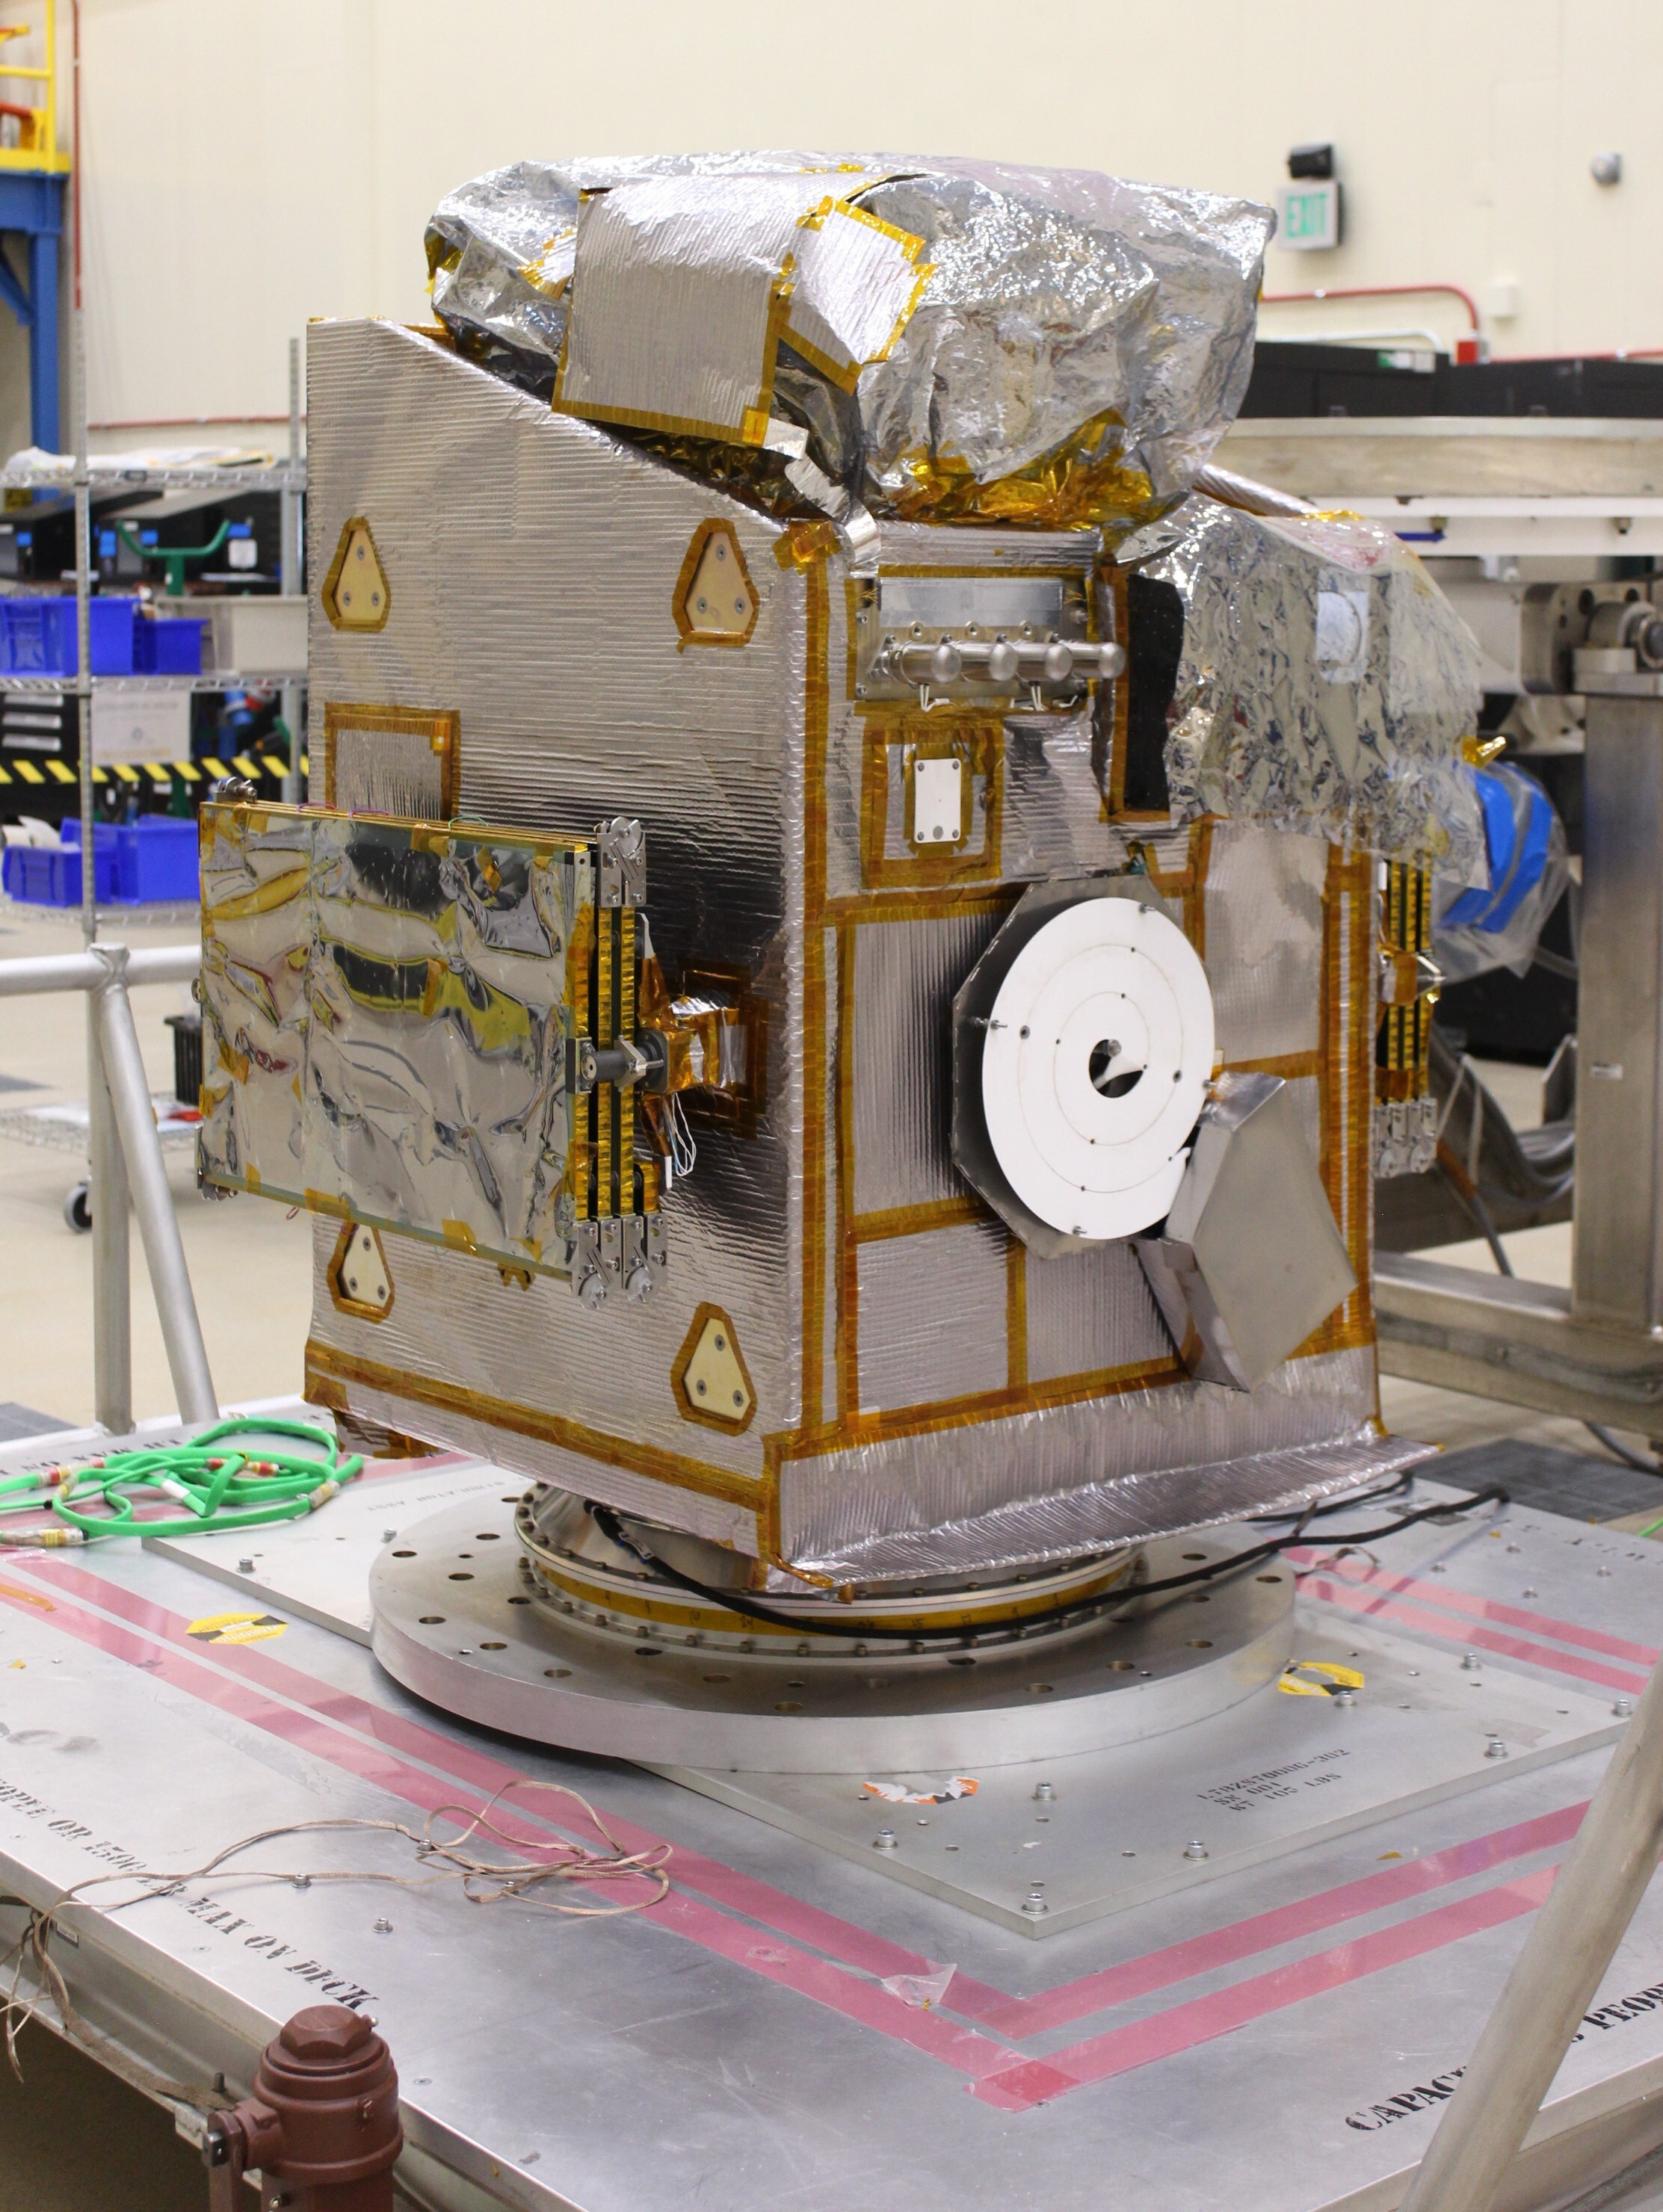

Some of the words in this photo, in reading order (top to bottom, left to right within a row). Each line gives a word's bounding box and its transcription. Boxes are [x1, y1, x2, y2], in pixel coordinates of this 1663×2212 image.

[1286, 191, 1327, 238] EXIT
[1303, 1772, 1342, 1788] LBS
[283, 1959, 380, 2010] DECK
